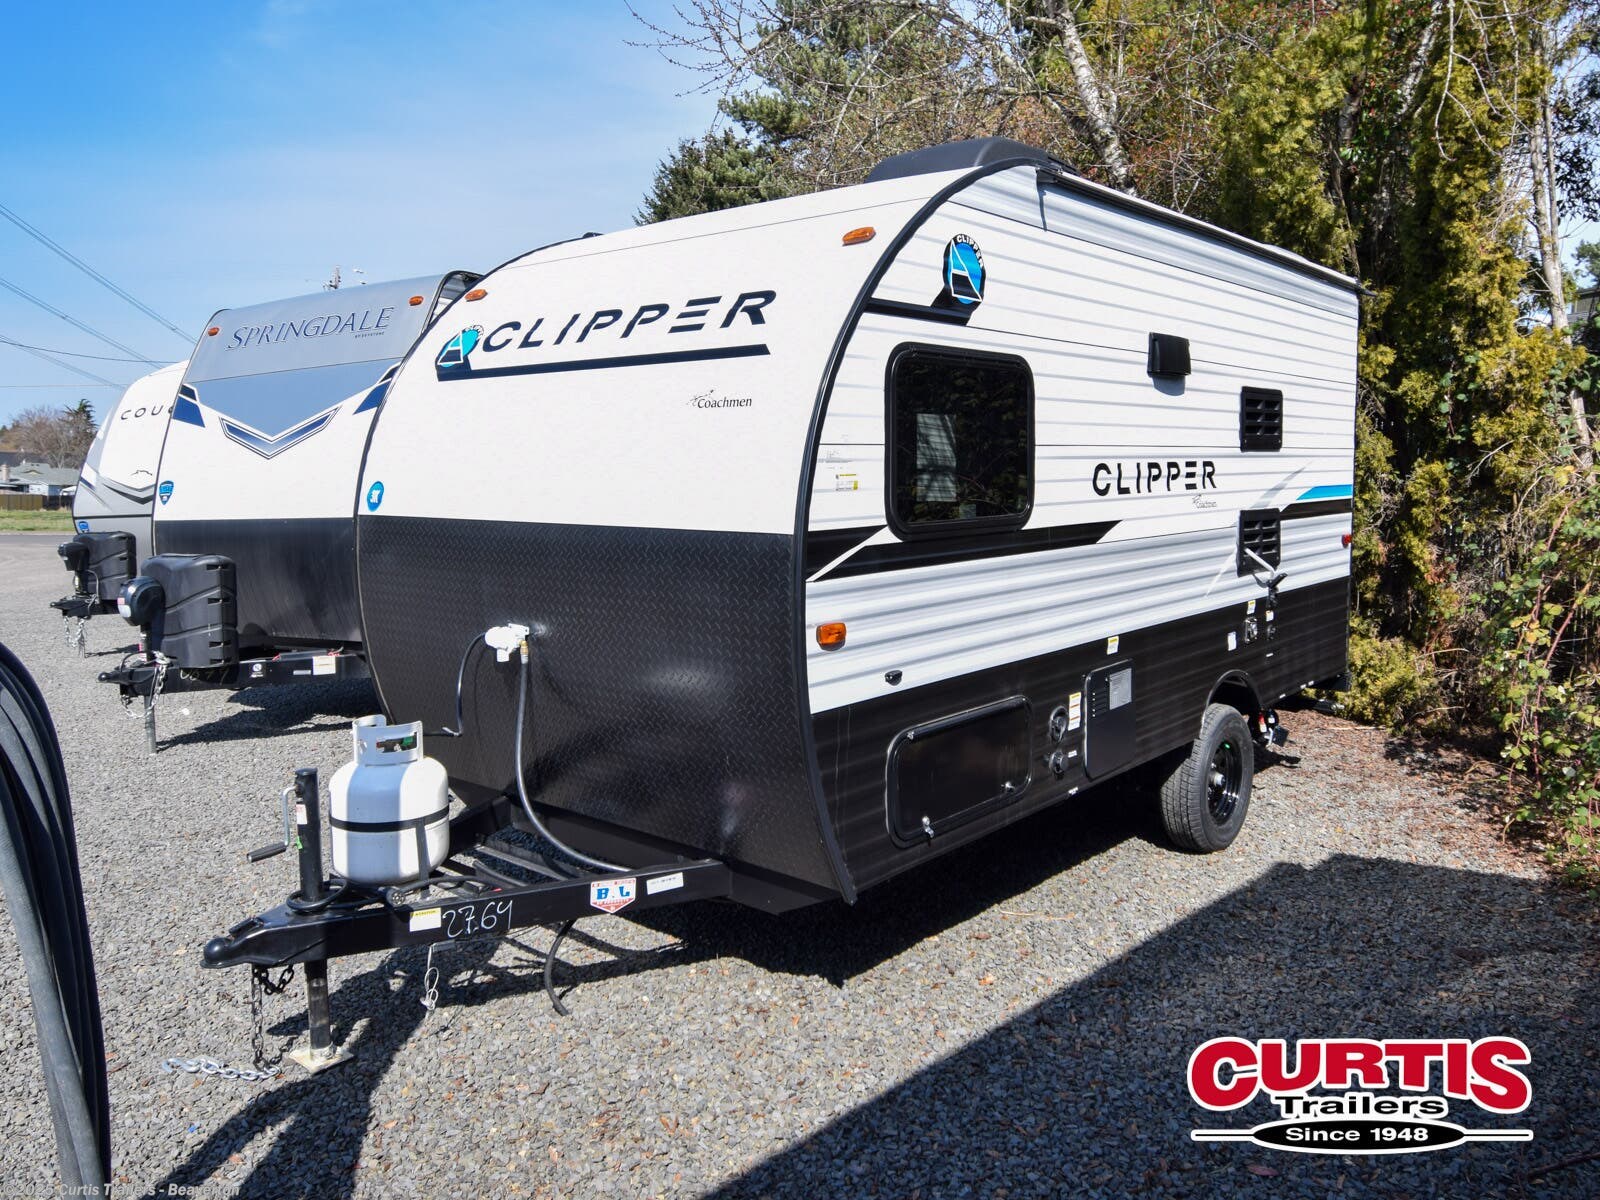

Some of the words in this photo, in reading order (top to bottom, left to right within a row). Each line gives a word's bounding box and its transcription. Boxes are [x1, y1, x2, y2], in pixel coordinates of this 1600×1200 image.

[225, 306, 396, 351] SPRINGDALE
[482, 290, 777, 353] CLIPPER
[697, 396, 752, 408] Coachmen
[1092, 460, 1217, 497] CLIPPER
